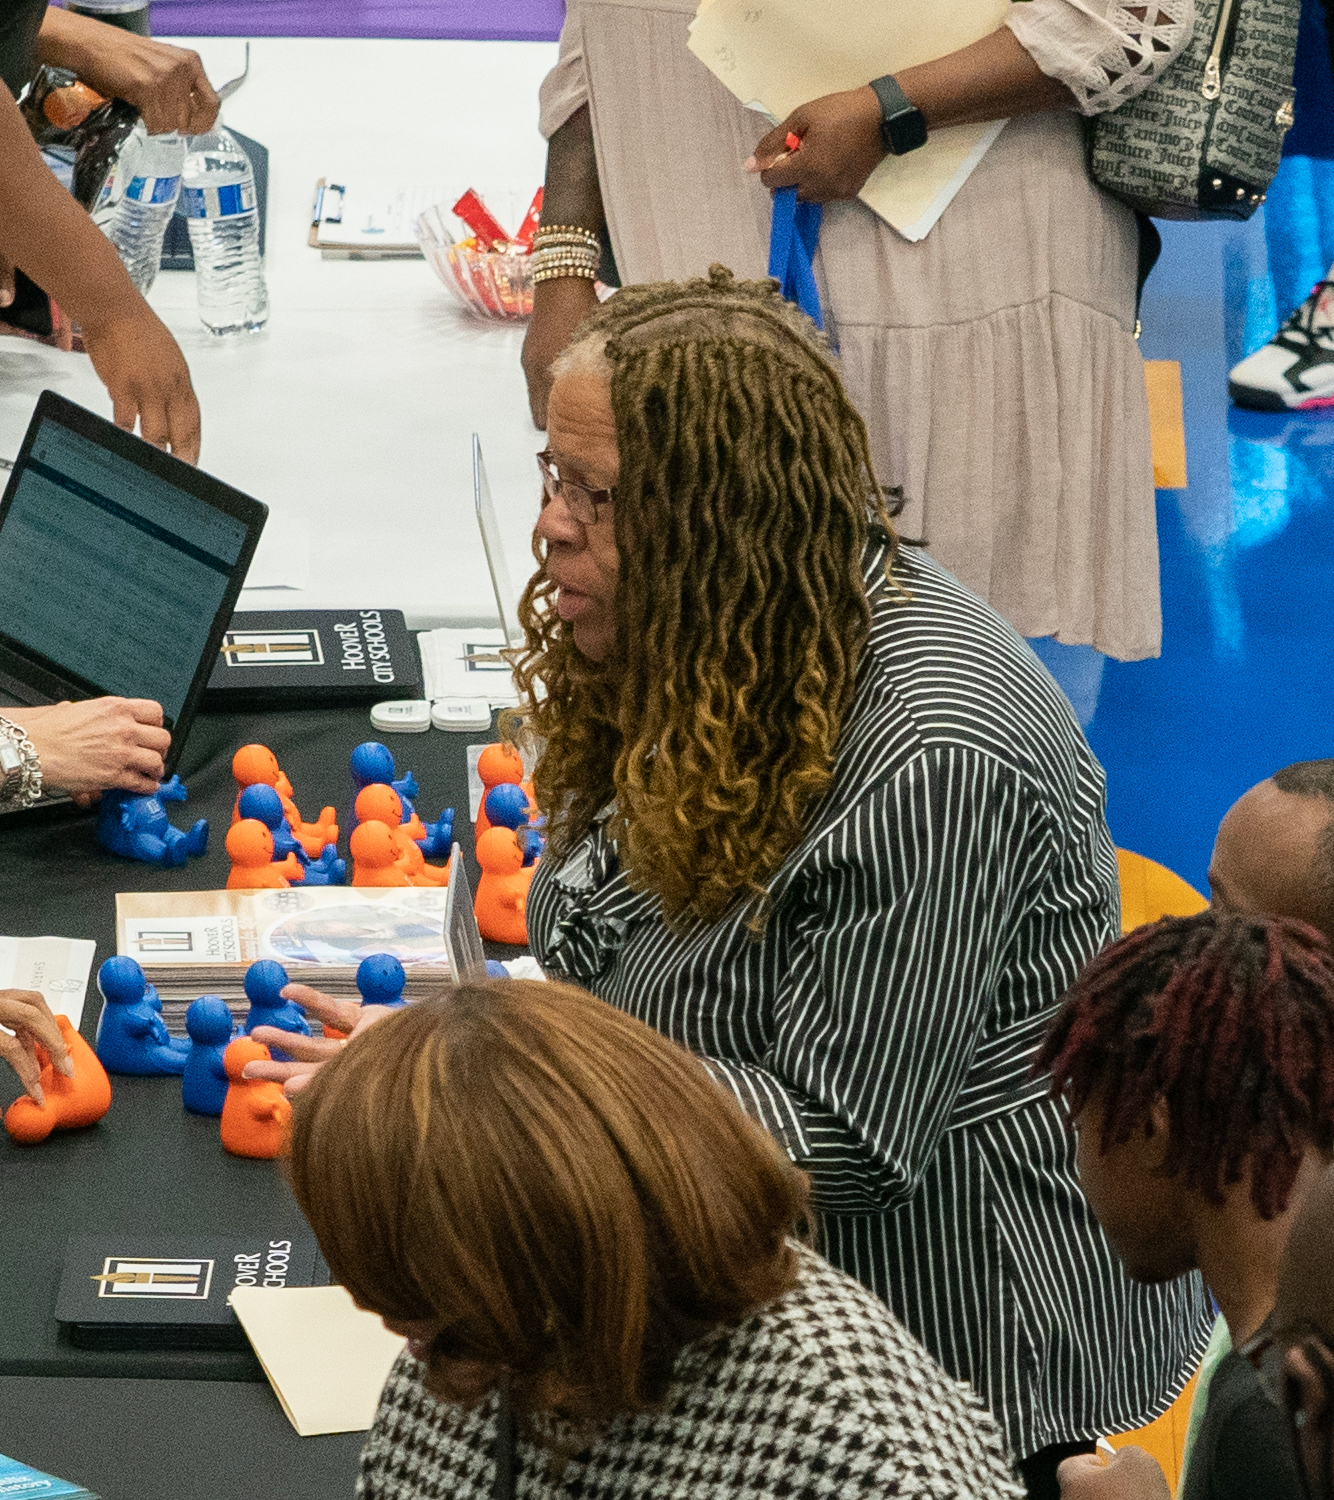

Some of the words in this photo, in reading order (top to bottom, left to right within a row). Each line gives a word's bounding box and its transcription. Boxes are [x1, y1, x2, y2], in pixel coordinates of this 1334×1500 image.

[334, 622, 367, 670] HOOVER
[359, 610, 390, 660] SCHOOLS
[373, 658, 395, 683] CITY
[205, 926, 220, 957] HOOVER
[221, 918, 235, 950] SCHOOLS
[263, 1240, 292, 1289] CHOOLS
